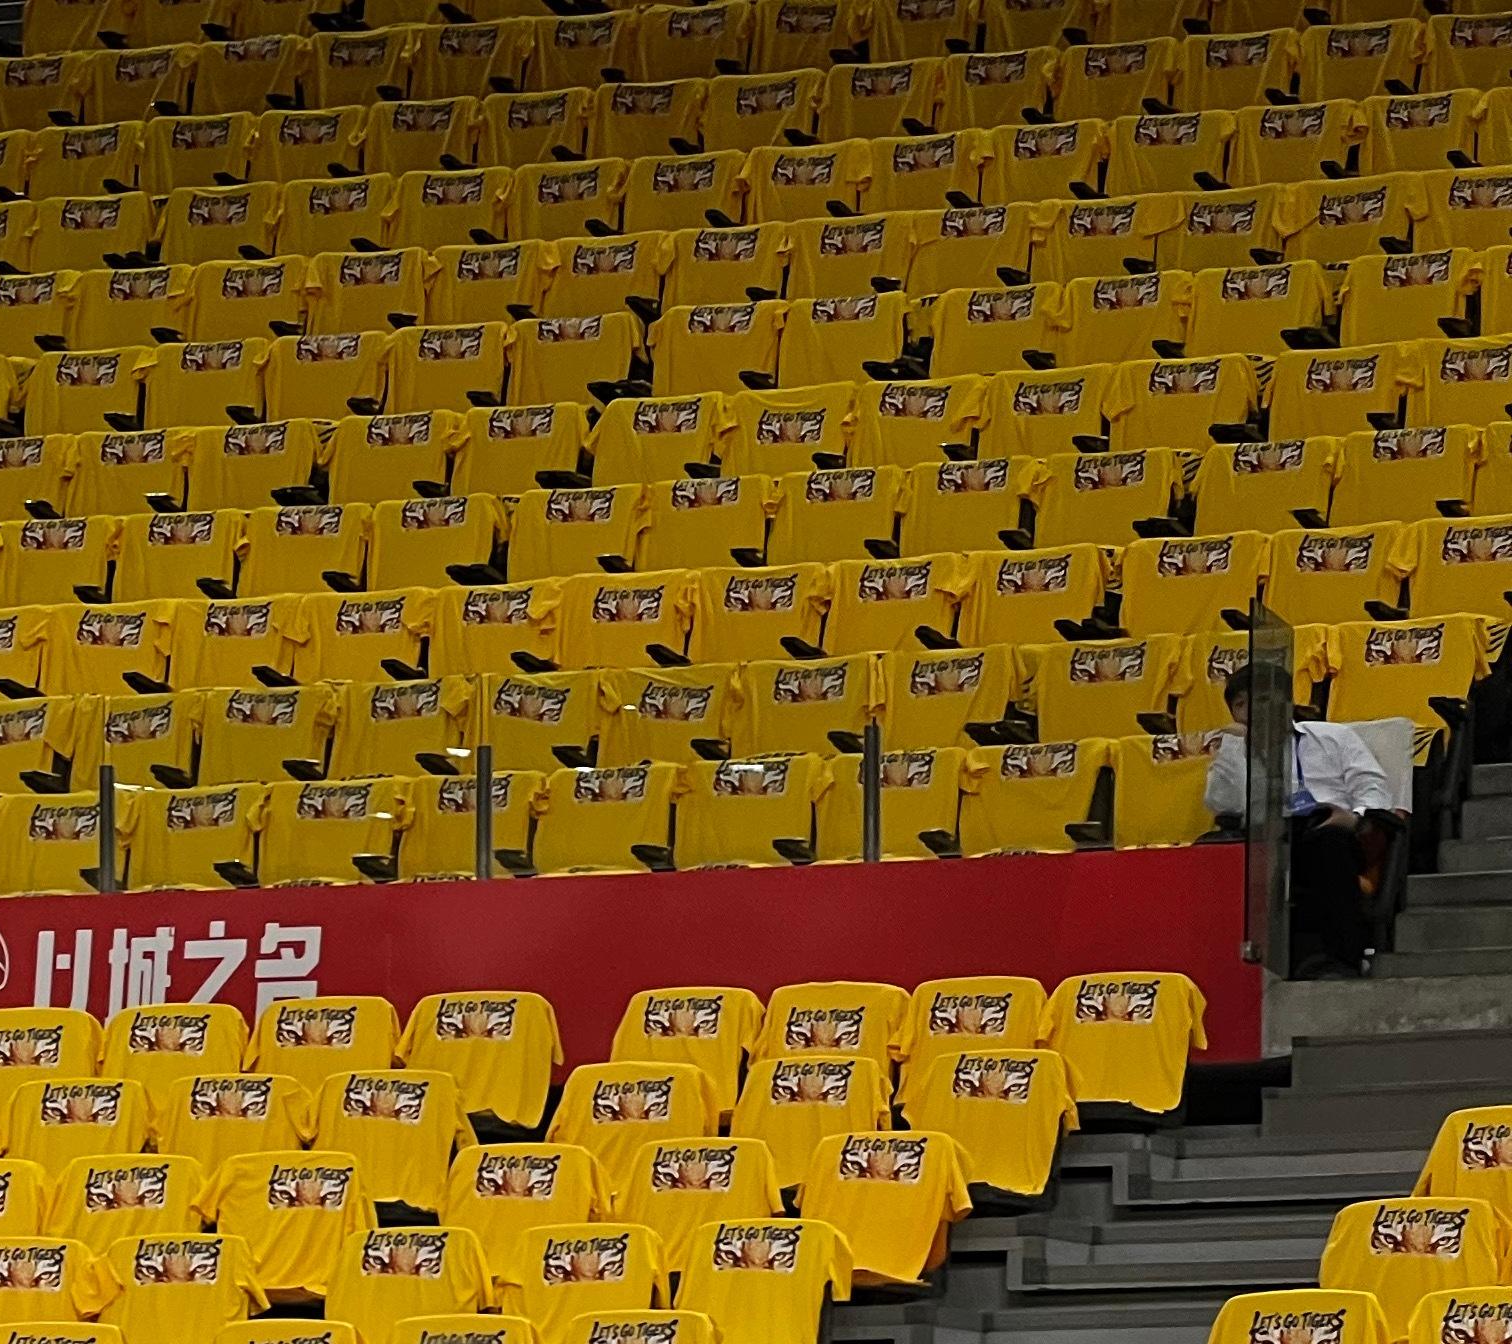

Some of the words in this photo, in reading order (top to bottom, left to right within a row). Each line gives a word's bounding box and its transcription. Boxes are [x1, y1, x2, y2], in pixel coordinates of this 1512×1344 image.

[34, 920, 322, 1028] 以城之名
[1076, 980, 1105, 999] LET'S
[1105, 982, 1120, 995] GO
[1121, 979, 1160, 999] TIGERS
[130, 1012, 158, 1030] LET'S
[158, 1014, 172, 1027] GO
[173, 1014, 210, 1032] TIGERS
[840, 1134, 871, 1154] LET'S
[871, 1137, 886, 1152] GO
[887, 1137, 928, 1158] TIGERS
[1372, 1205, 1406, 1226] LET'S
[1406, 1208, 1423, 1223] GO
[1424, 1208, 1469, 1230] TIGERS
[588, 1321, 619, 1343] LET'S
[620, 1323, 635, 1338] GO
[636, 1319, 678, 1342] TIGERS
[1249, 1310, 1282, 1333] LET'S
[1283, 1312, 1299, 1328] GO
[1301, 1308, 1346, 1333] TIGERS
